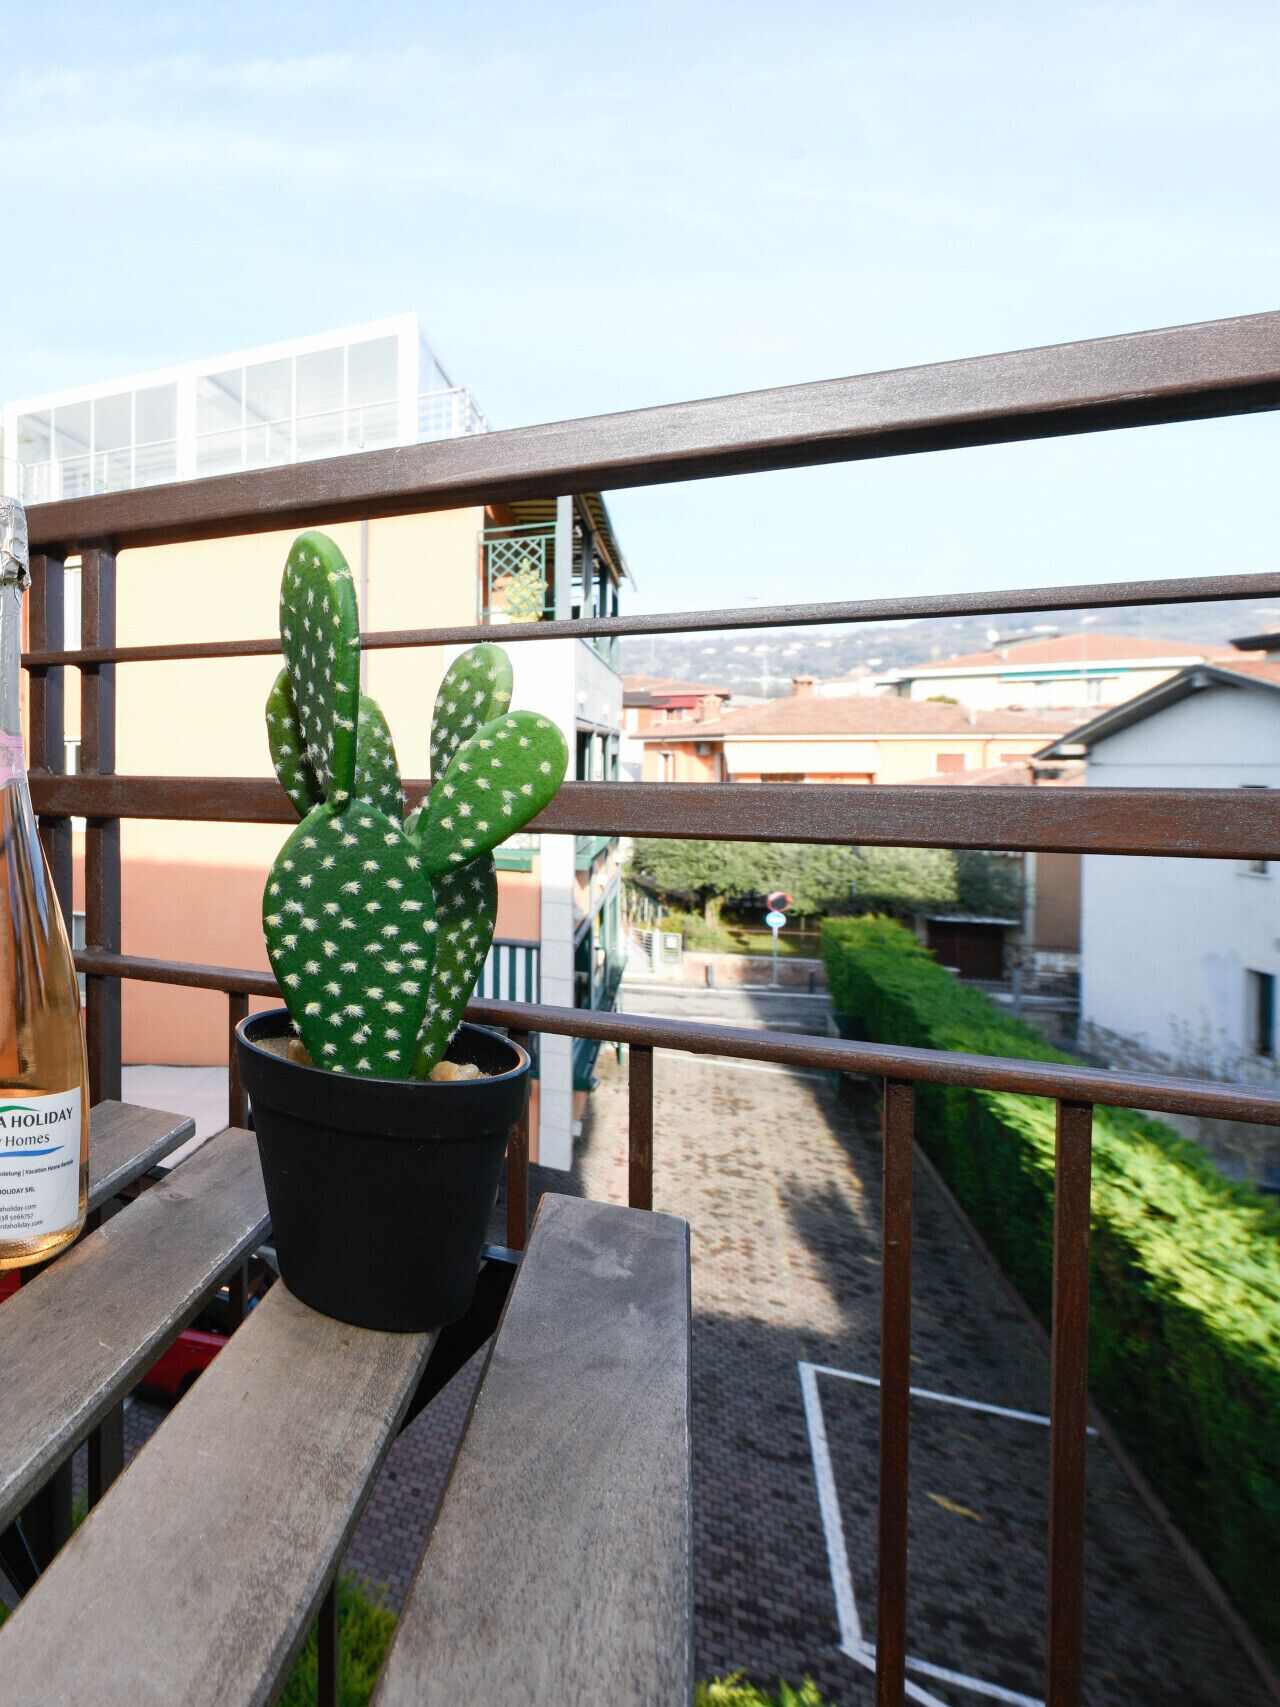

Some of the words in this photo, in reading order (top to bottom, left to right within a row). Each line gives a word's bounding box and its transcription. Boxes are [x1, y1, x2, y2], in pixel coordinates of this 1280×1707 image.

[11, 1107, 74, 1128] HOLIDAY
[6, 1133, 50, 1147] Homes
[25, 1167, 46, 1175] Vacation
